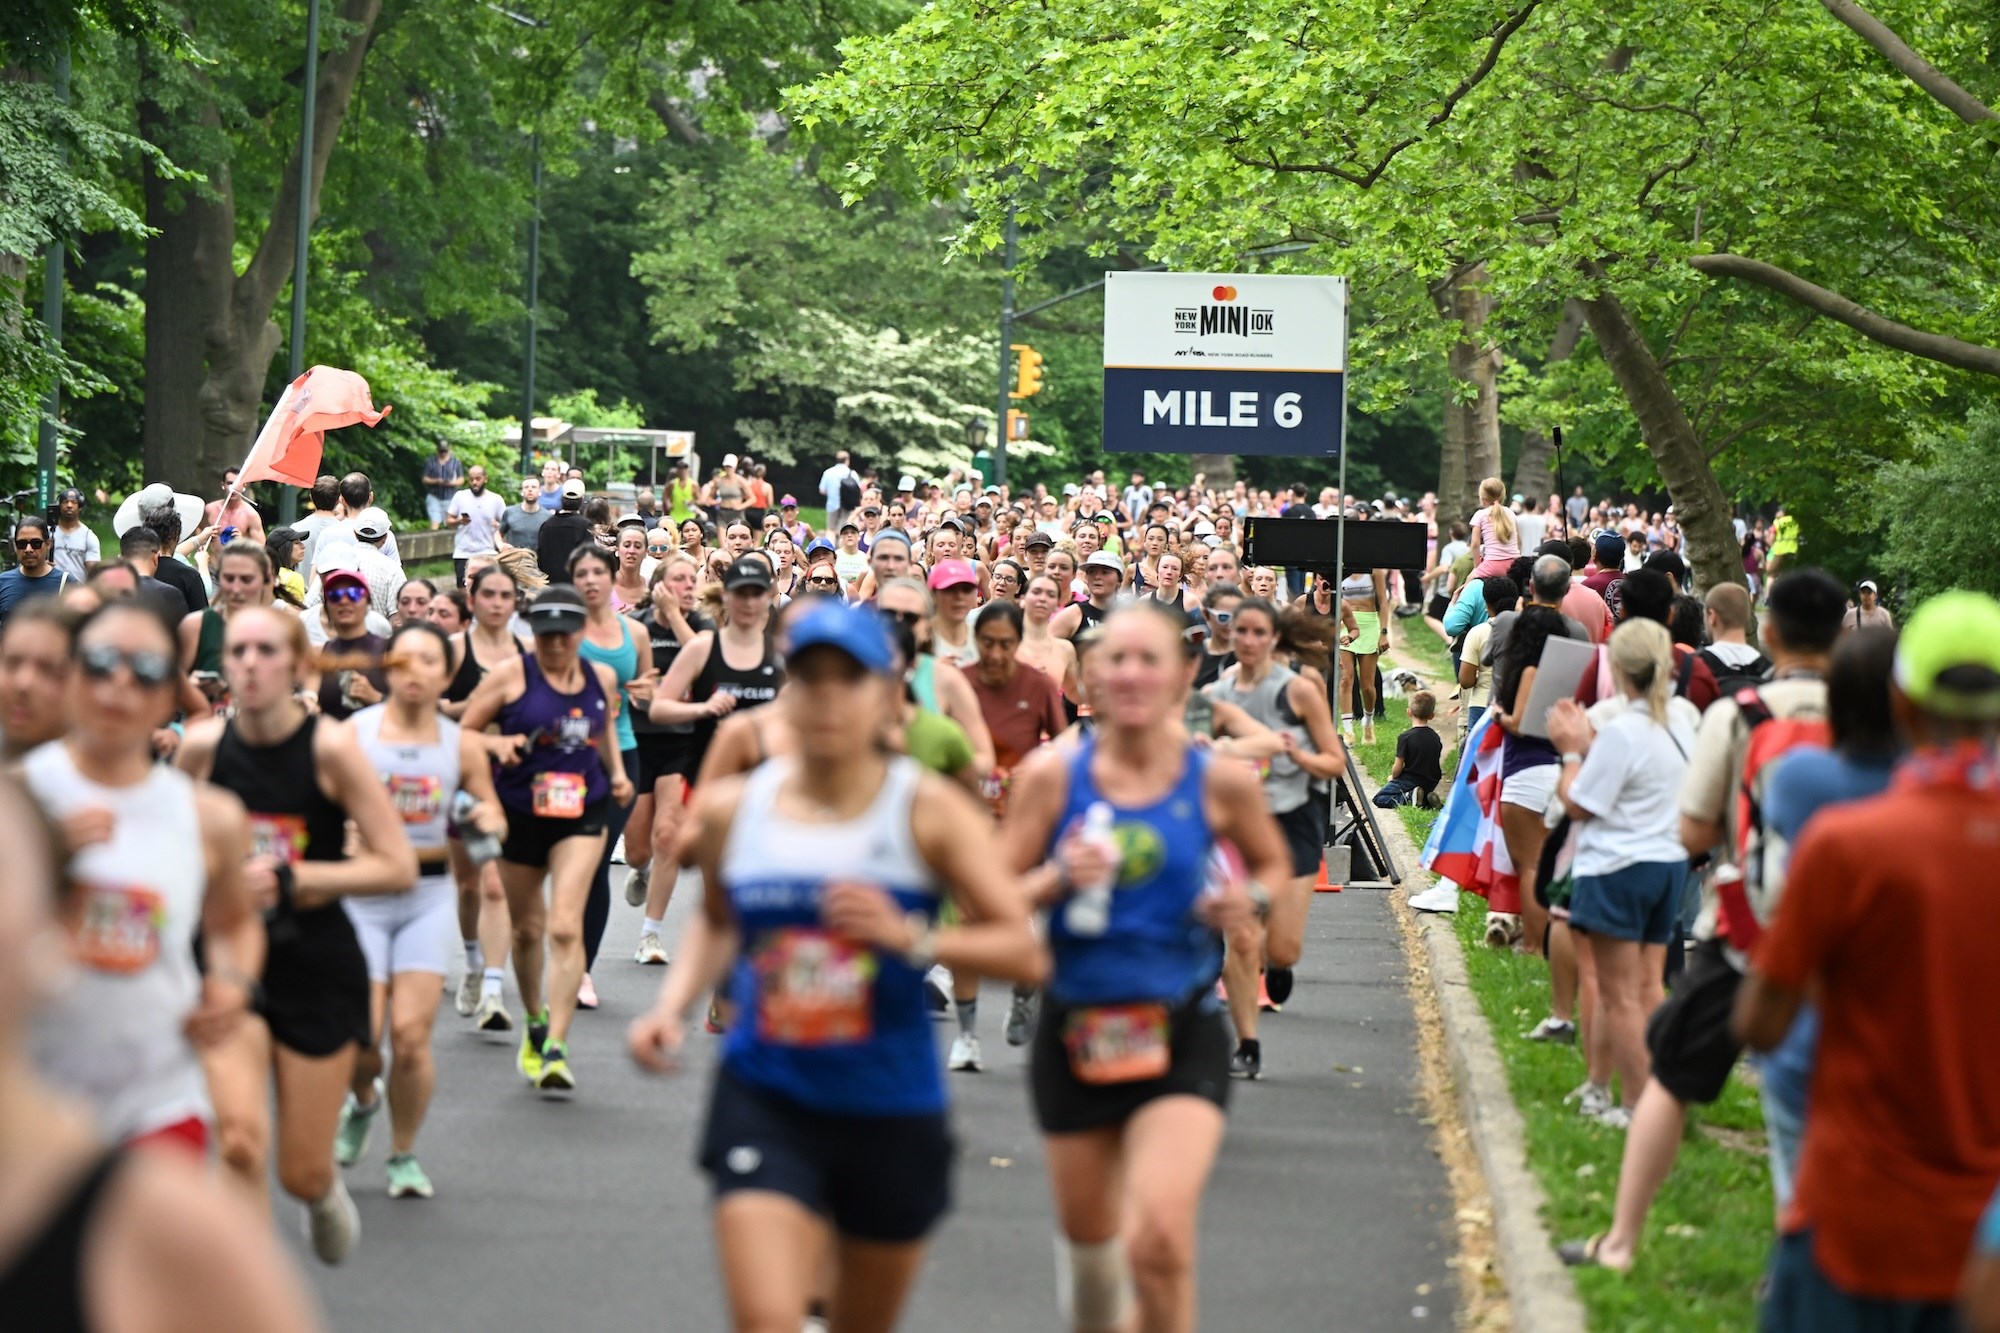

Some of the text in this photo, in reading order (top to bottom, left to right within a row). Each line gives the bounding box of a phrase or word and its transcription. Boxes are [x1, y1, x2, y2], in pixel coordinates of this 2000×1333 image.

[1175, 312, 1197, 321] NEW
[1175, 321, 1197, 329] YORK
[1200, 305, 1248, 338] MINI
[1251, 313, 1273, 331] 10K
[1143, 389, 1303, 429] MILE 6
